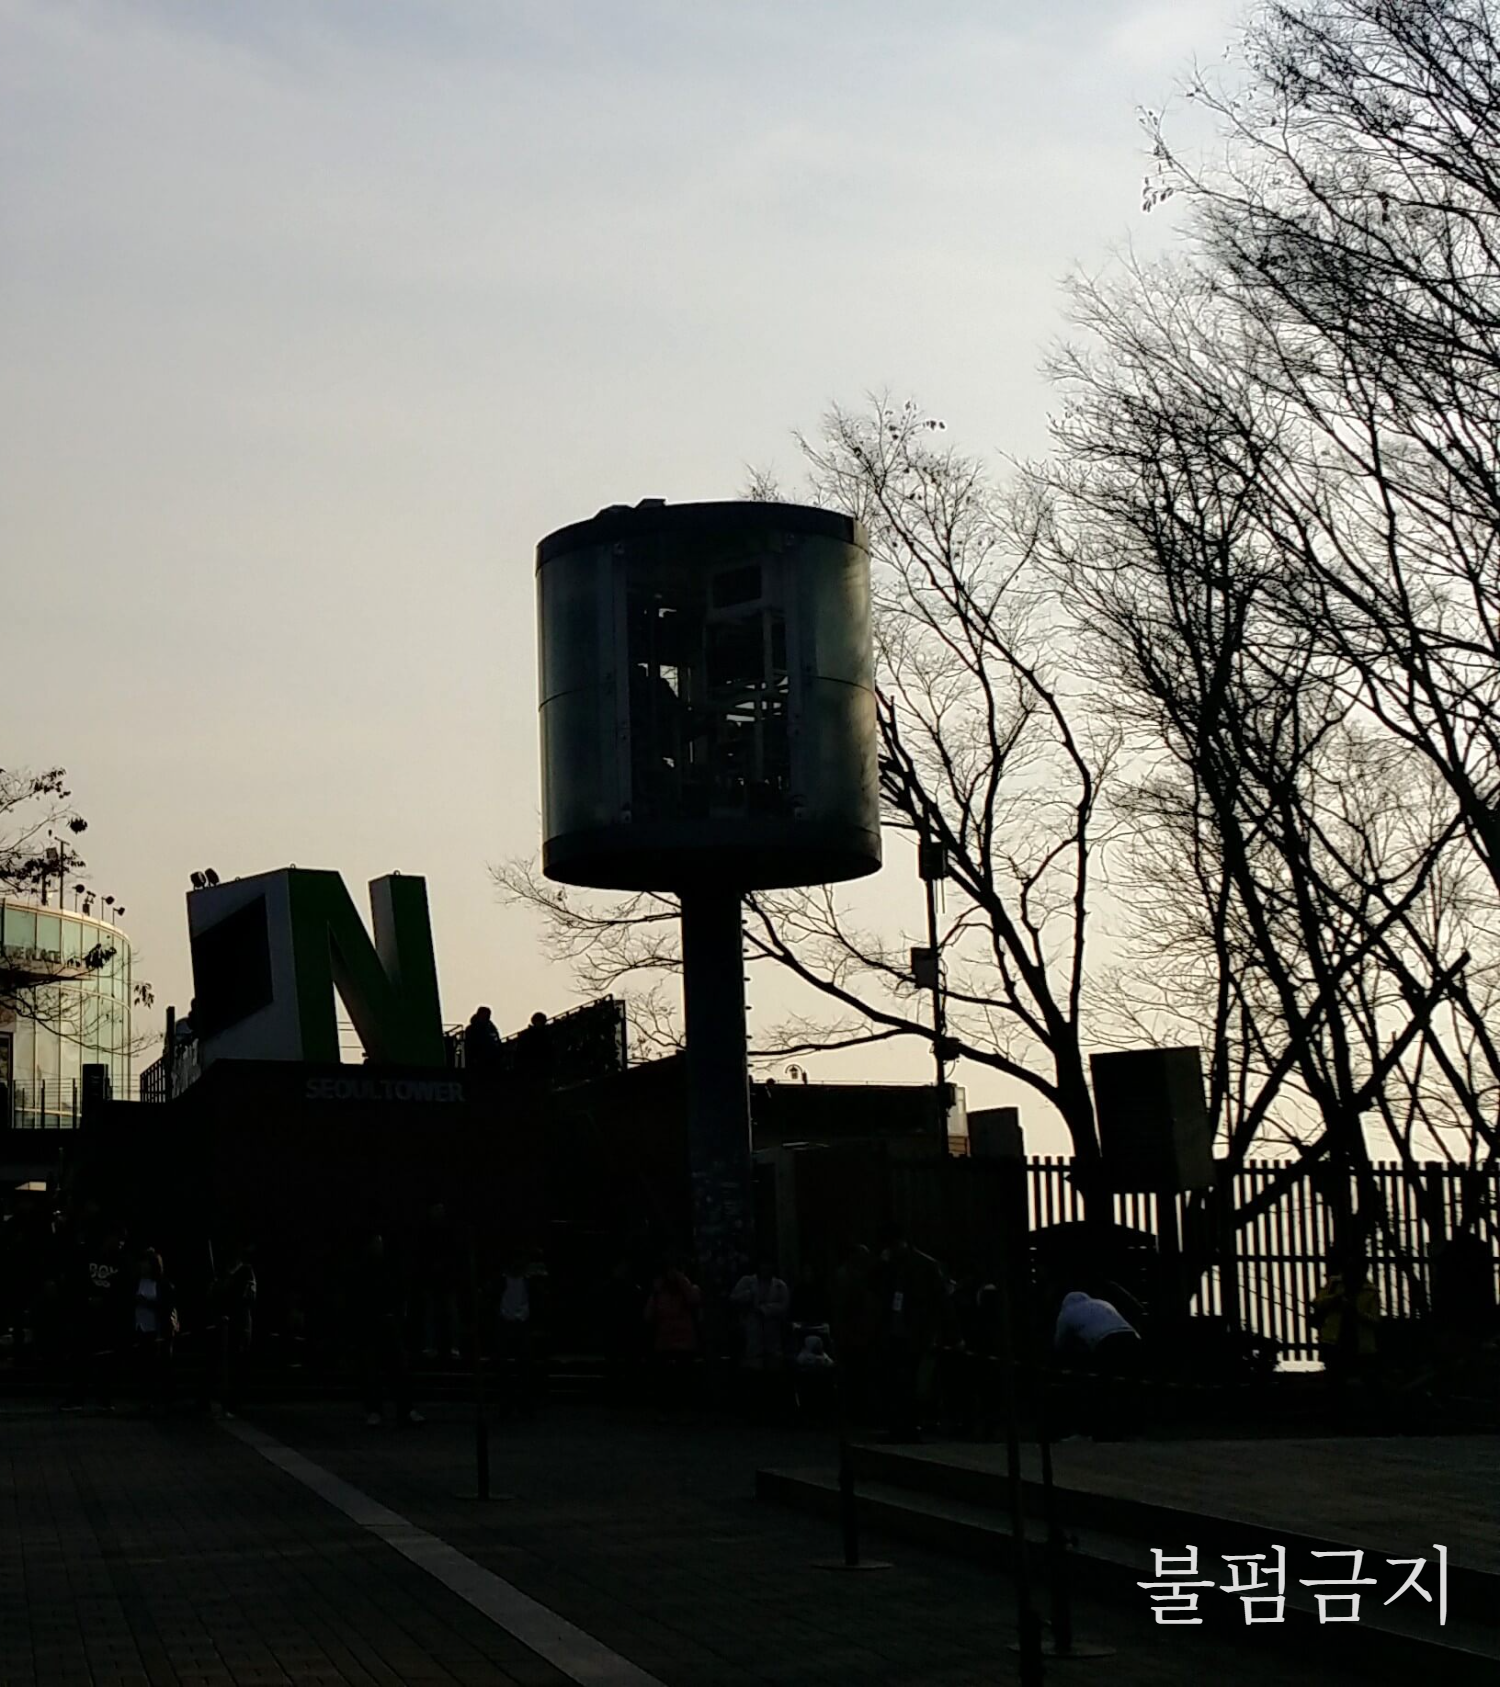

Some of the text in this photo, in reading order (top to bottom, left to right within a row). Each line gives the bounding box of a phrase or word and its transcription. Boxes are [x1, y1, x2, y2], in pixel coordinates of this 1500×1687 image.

[288, 868, 448, 1068] N
[305, 1078, 467, 1103] SEOUL TOWER
